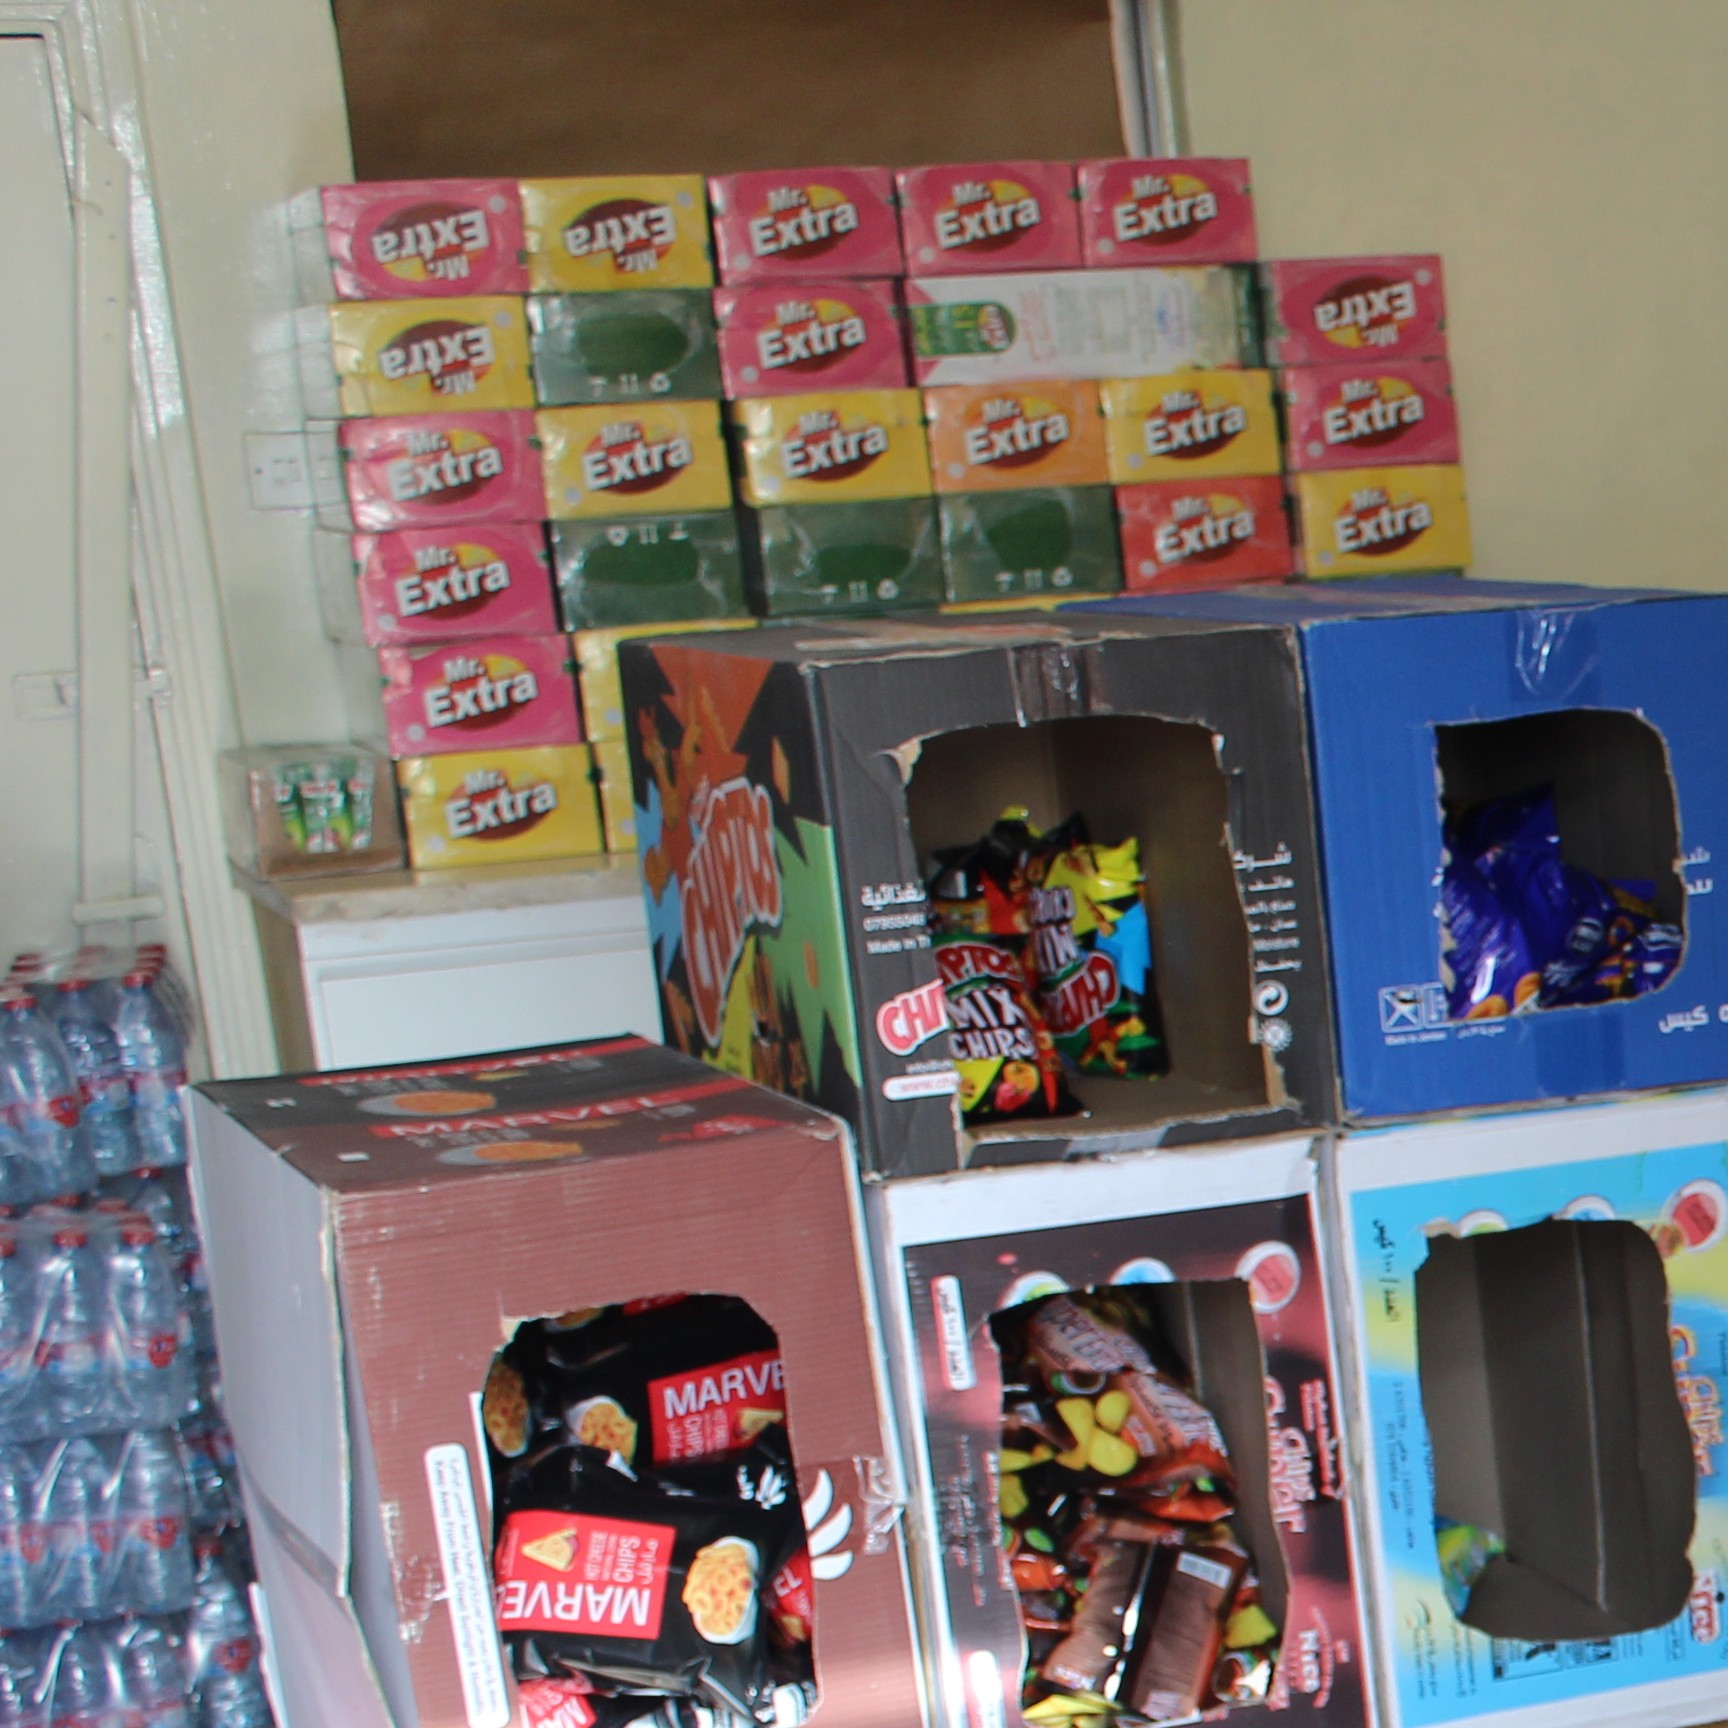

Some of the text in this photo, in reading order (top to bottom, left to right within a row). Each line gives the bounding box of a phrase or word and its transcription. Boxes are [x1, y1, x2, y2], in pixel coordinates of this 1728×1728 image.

[371, 210, 488, 263] Extra
[565, 206, 676, 257] Extra
[748, 201, 858, 257] Extra
[934, 196, 1040, 251] Extra
[1112, 191, 1218, 243] Extra
[1314, 281, 1415, 331] Extra
[379, 325, 494, 380] Extra
[757, 316, 866, 369] Extra
[963, 411, 1070, 467] Extra
[1143, 403, 1246, 457] Extra
[1322, 392, 1424, 445] Extra
[387, 444, 502, 503] Extra
[583, 434, 692, 489] Extra
[780, 423, 887, 480] Extra
[1154, 508, 1256, 563] Extra
[1333, 503, 1433, 552] Extra
[394, 557, 510, 617] Extra
[422, 669, 538, 728] Extra
[444, 781, 558, 838] Extra
[947, 988, 1026, 1028] MIX
[950, 1028, 1038, 1059] CHIPS
[444, 1522, 458, 1546] From
[614, 1536, 641, 1583] CHIPS
